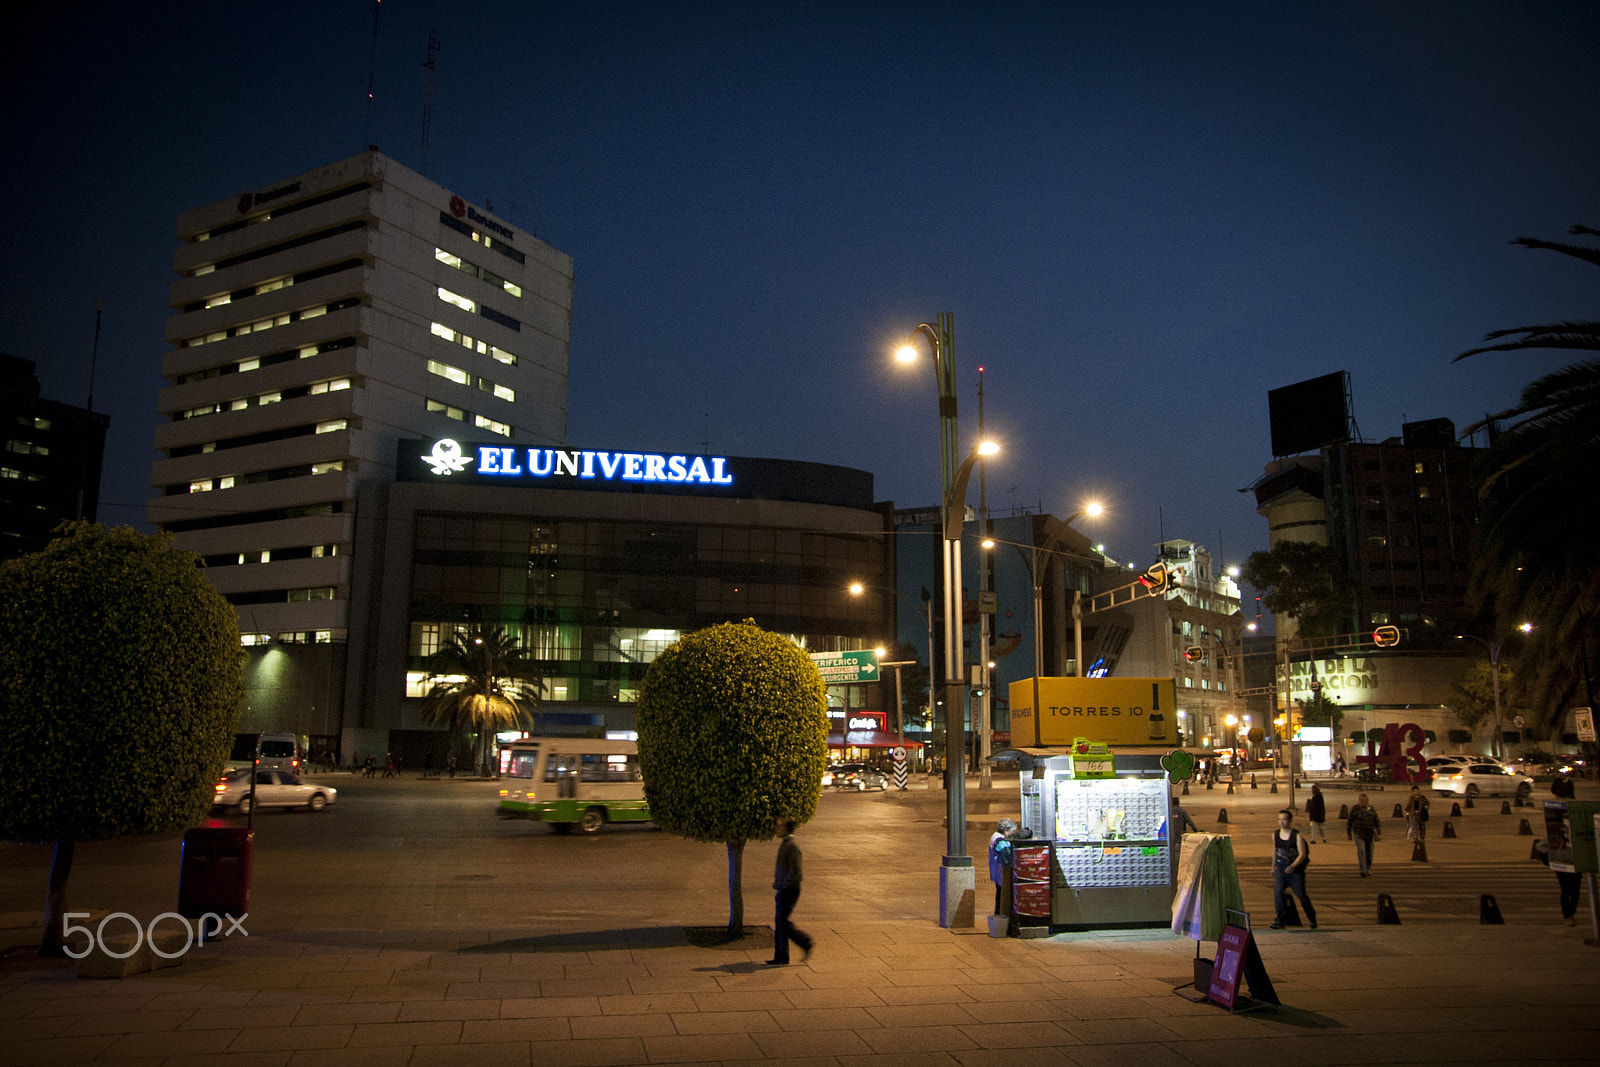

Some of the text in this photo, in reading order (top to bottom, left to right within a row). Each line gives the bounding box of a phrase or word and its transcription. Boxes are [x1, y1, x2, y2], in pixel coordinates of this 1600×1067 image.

[254, 182, 301, 206] Banamex
[467, 206, 515, 241] Banamex
[477, 445, 735, 486] EL UNIVERSAL
[812, 657, 858, 667] ERIFERICO
[1324, 659, 1345, 674] DE
[1352, 658, 1377, 673] LA
[1049, 706, 1144, 717] TORRES 10
